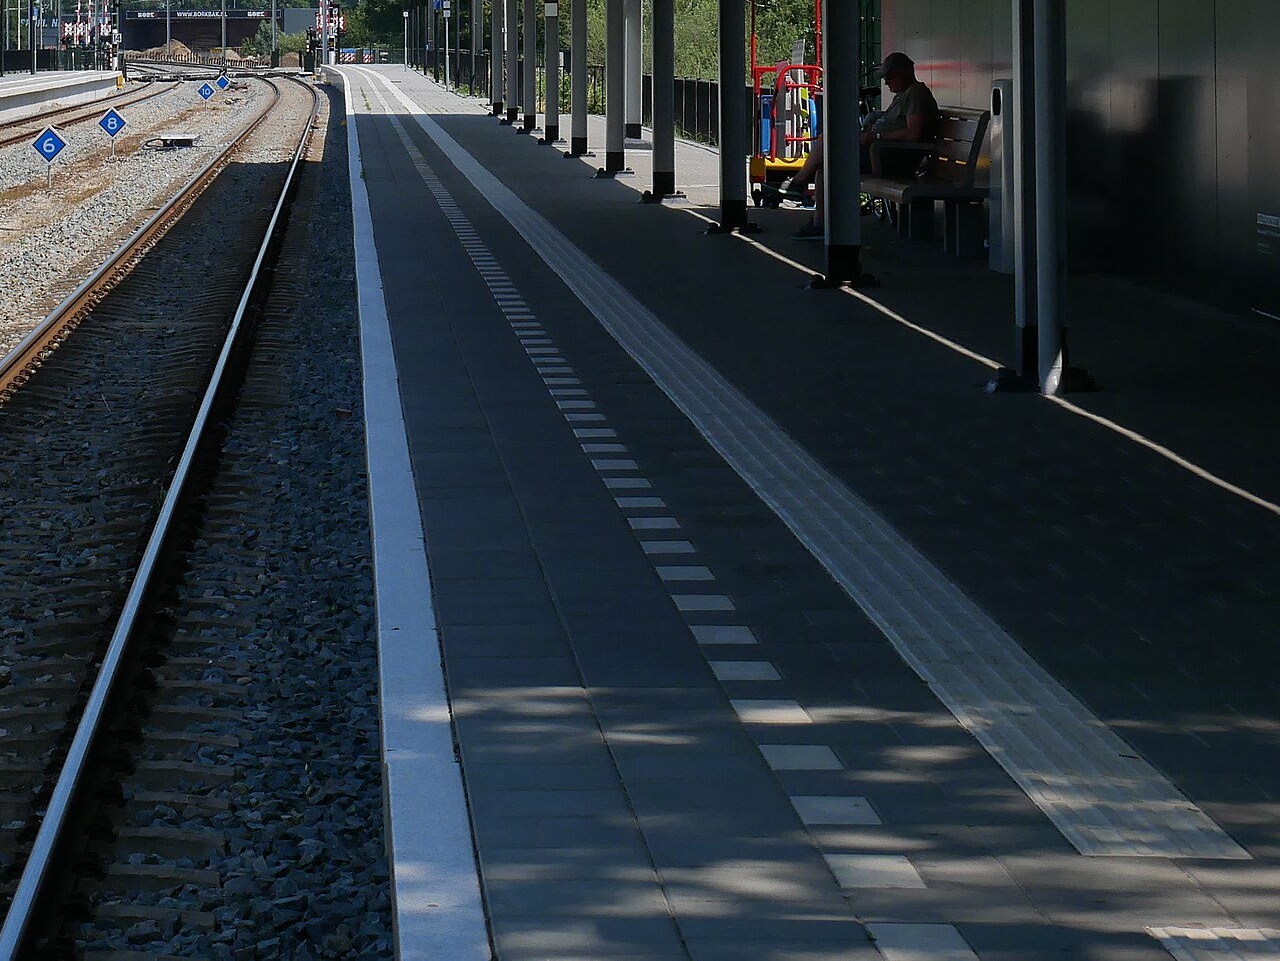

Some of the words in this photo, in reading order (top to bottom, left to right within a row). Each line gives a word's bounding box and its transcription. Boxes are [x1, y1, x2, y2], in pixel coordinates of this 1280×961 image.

[113, 34, 122, 42] 14
[201, 88, 211, 96] 10
[107, 116, 118, 130] 8
[42, 137, 55, 153] 6
